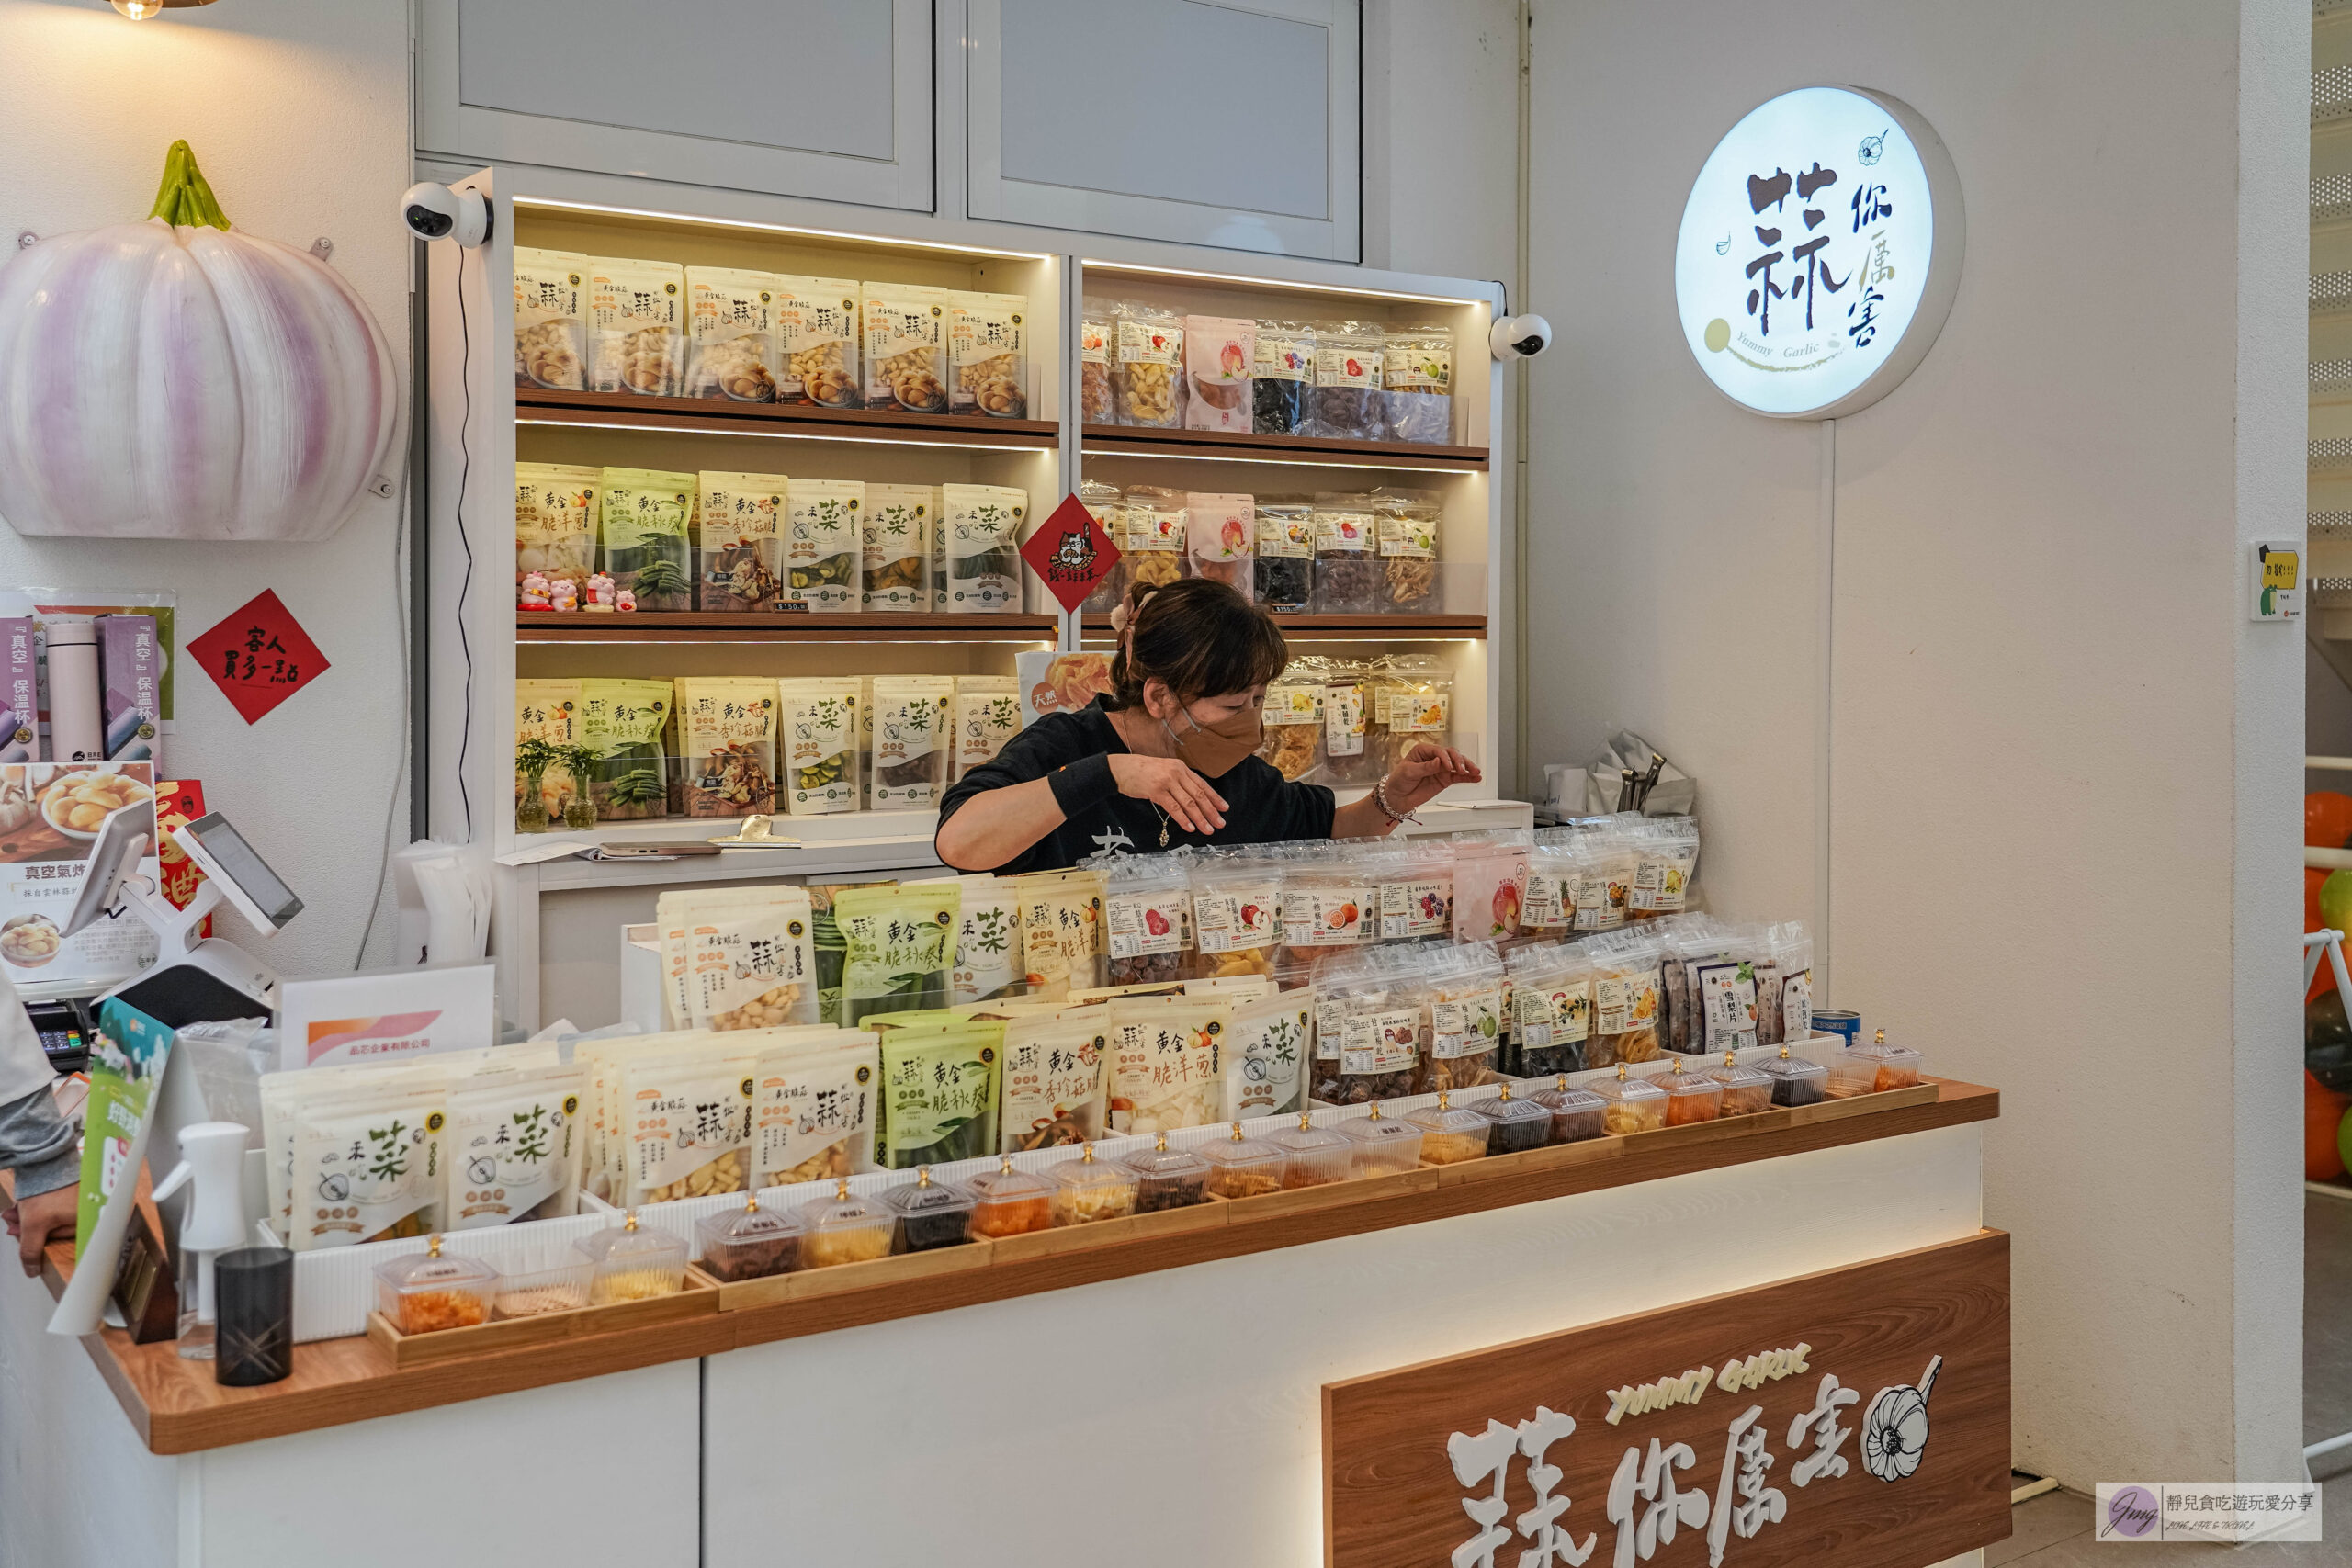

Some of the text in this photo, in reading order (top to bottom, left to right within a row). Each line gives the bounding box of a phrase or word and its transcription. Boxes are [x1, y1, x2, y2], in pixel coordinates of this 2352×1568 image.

[1746, 162, 1854, 336] 蒜
[1736, 330, 1820, 359] Yummy Garlic
[545, 492, 567, 510] 黃金
[638, 495, 661, 513] 黃金
[735, 497, 757, 514] 黃金
[243, 626, 287, 654] 客人
[223, 650, 299, 683] 買多一點
[723, 703, 745, 719] 黃金
[1032, 690, 1057, 708] 天然
[521, 706, 546, 724] 黃金
[615, 705, 637, 723] 黃金
[886, 920, 918, 944] 黃金
[977, 907, 1010, 955] 菜
[1058, 908, 1080, 931] 黃金
[1155, 1030, 1184, 1055] 黃金
[1269, 1018, 1298, 1066] 菜
[1048, 1048, 1076, 1076] 黃金
[933, 1064, 961, 1088] 黃金
[514, 1103, 551, 1164] 菜
[369, 1119, 411, 1182] 菜
[1607, 1342, 1813, 1426] YUMMY GARLIC
